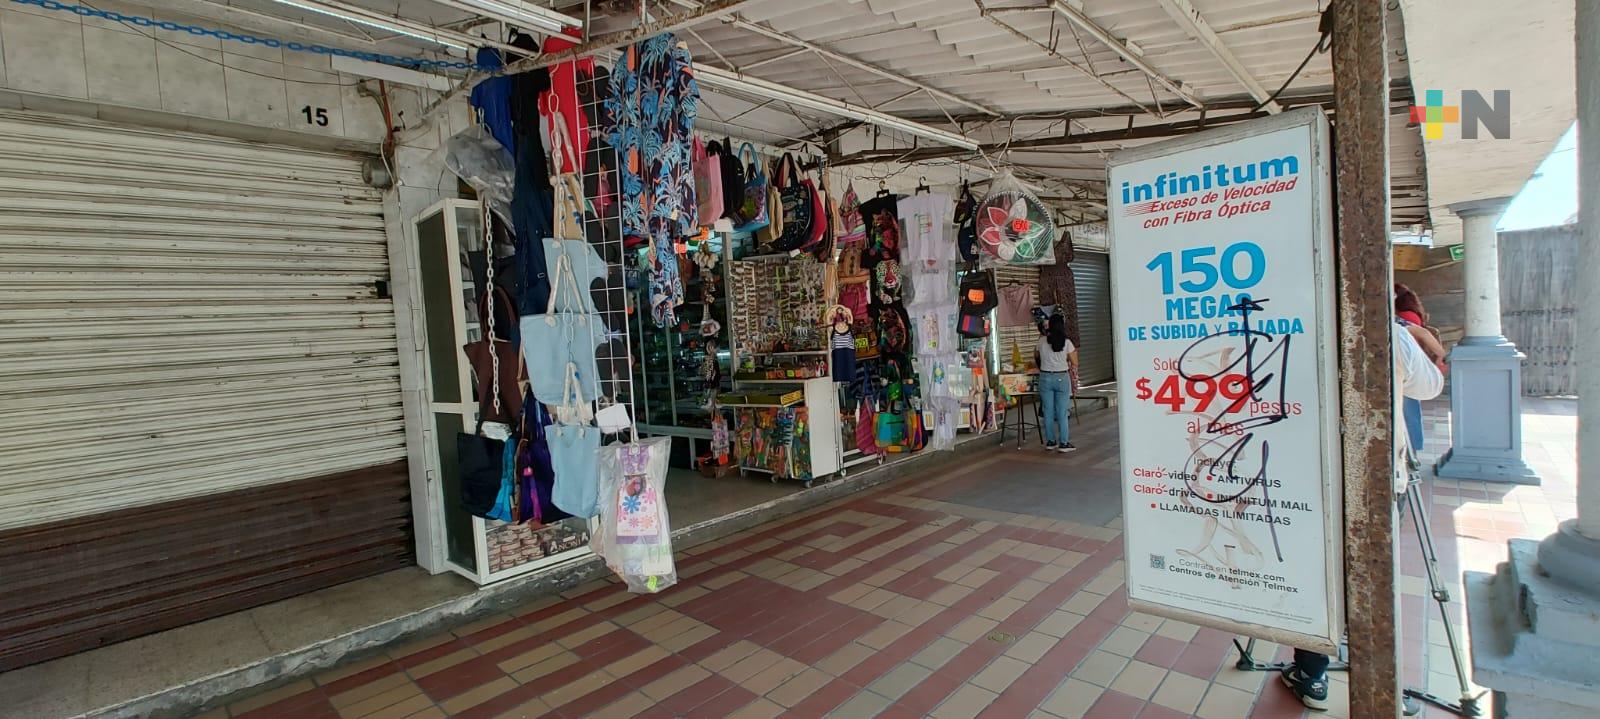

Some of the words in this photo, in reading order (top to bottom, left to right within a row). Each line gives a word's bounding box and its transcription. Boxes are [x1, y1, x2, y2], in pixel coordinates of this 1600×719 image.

[302, 105, 328, 126] 15
[1122, 155, 1298, 204] infinitum
[1151, 196, 1198, 213] Exceso
[1201, 192, 1219, 204] de
[1223, 177, 1298, 200] Velocidad
[1143, 215, 1169, 229] con
[1173, 209, 1212, 224] Fibra
[1218, 200, 1271, 219] Óptica
[1146, 242, 1266, 295] 150
[1166, 293, 1253, 321] MEGAS
[1128, 327, 1147, 341] DE
[1151, 323, 1209, 340] SUBIDA
[1135, 373, 1251, 414] $499
[1250, 401, 1302, 417] pesos
[1187, 418, 1200, 434] al
[1208, 421, 1244, 436] mes
[1217, 475, 1282, 488] ANTIVIRUS
[1160, 503, 1219, 517] LLAMADAS
[1223, 510, 1291, 526] ILIMITADAS
[1217, 494, 1277, 508] INFINITUM
[1281, 501, 1312, 511] MAIL
[1169, 565, 1202, 577] Centros
[1205, 572, 1216, 580] de
[1218, 574, 1260, 588] Atención
[1263, 581, 1298, 594] Telmex
[1229, 568, 1285, 583] telmex.com
